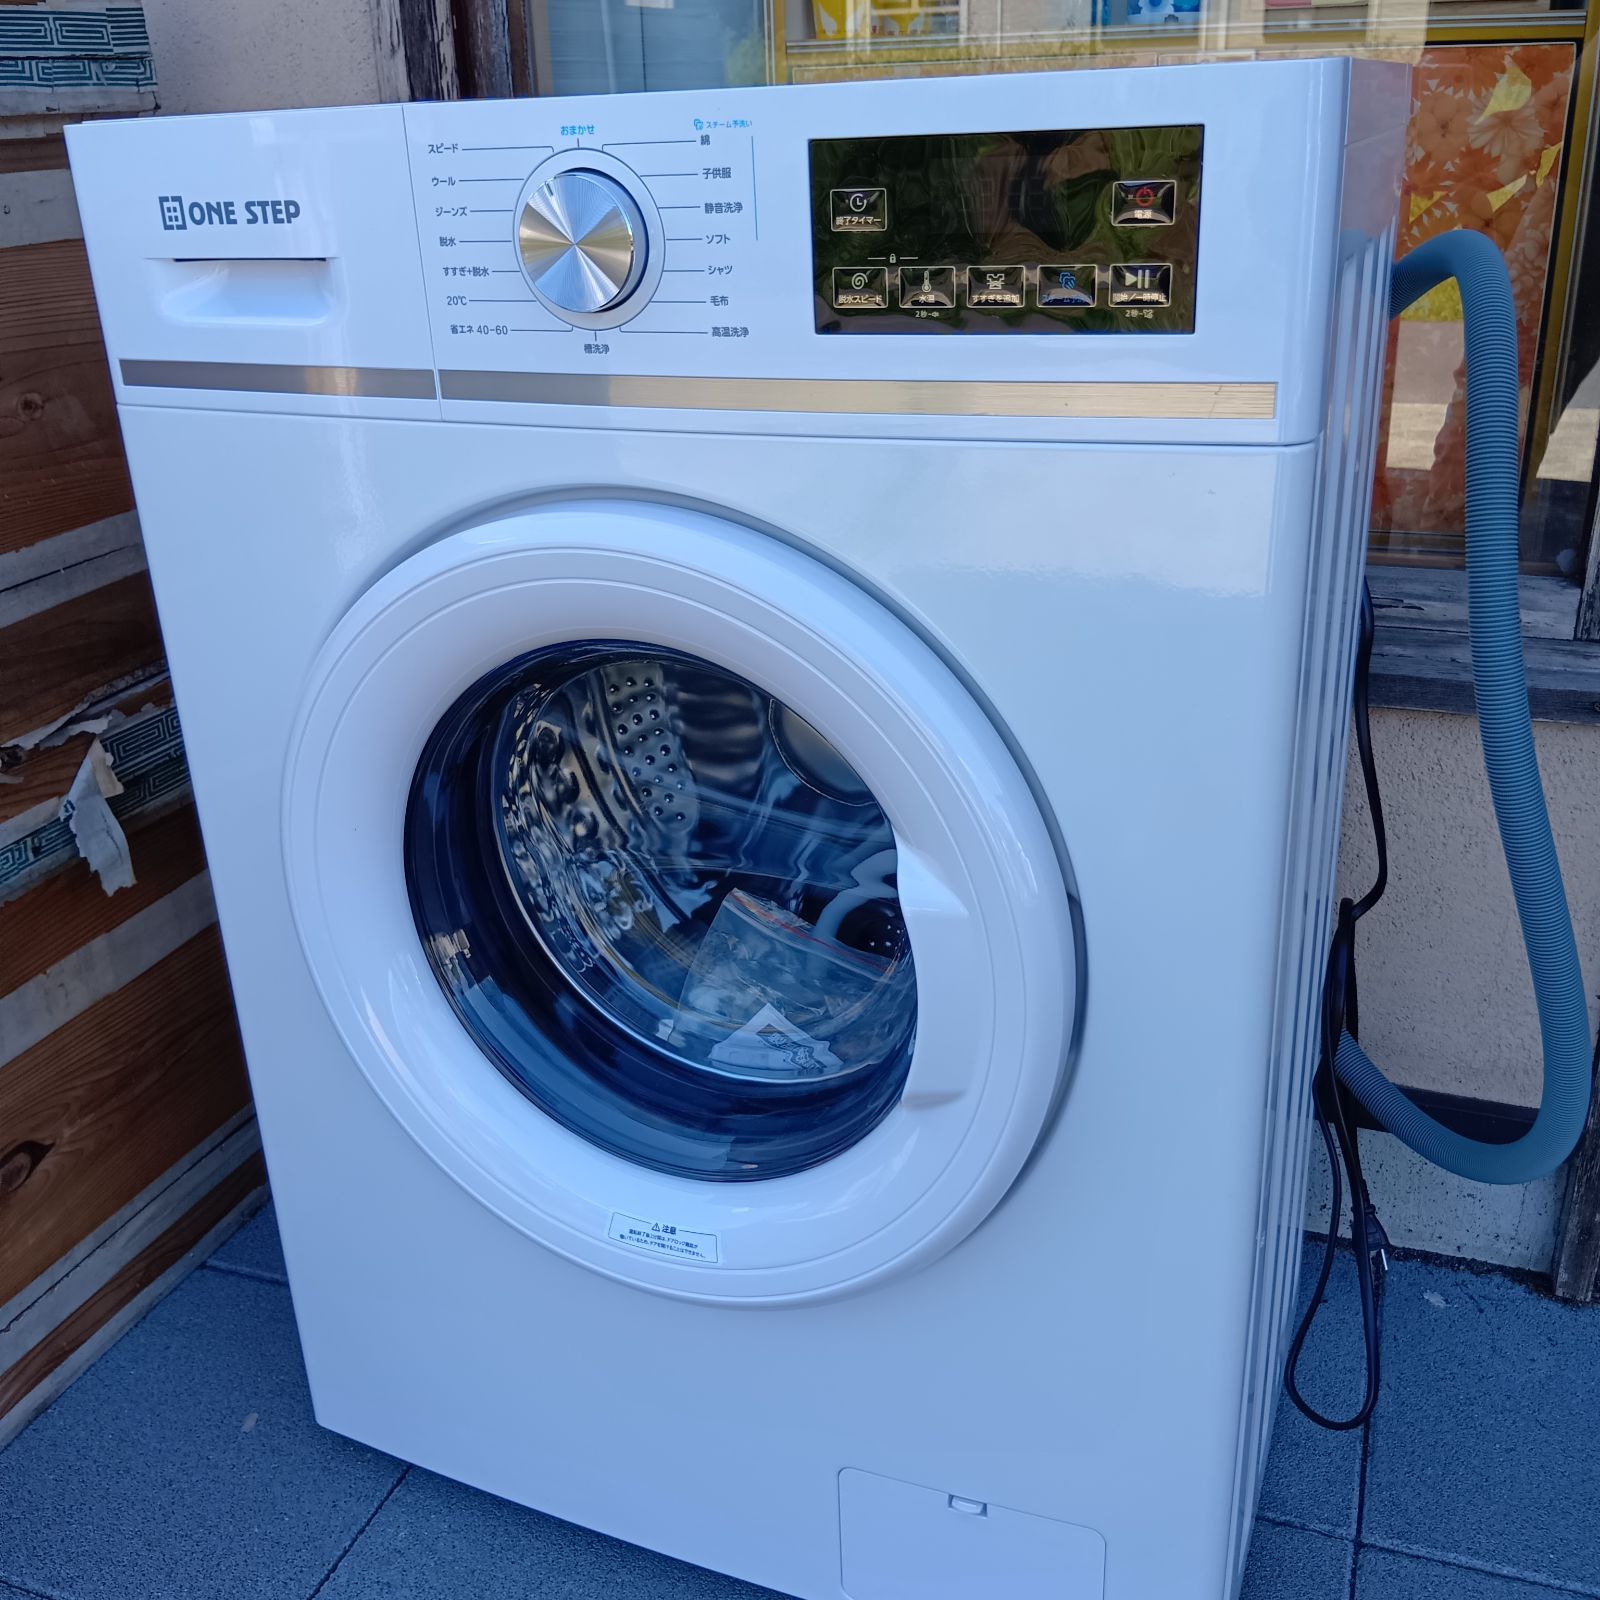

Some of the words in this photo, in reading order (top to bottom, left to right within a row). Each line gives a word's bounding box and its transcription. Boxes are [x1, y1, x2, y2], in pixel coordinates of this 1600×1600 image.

[560, 125, 595, 136] おまかせ
[700, 134, 711, 146] 綿
[427, 143, 459, 154] スピード
[702, 167, 732, 179] 子供服
[431, 176, 456, 187] ウール
[188, 201, 238, 226] ONE
[244, 199, 301, 225] STEP
[435, 206, 468, 217] ジーンズ
[704, 201, 744, 214] 静音洗浄
[835, 216, 882, 226] 終了タイマー
[439, 236, 457, 247] 脱水
[705, 233, 731, 245] ソフト
[442, 266, 490, 278] すすぎ+脱水
[707, 265, 733, 275] シャツ
[710, 295, 729, 306] 毛布
[838, 295, 882, 304] 脱水スピード
[450, 324, 474, 335] 省エネ
[476, 325, 508, 336] 40-60
[711, 326, 750, 338] 高温洗浄
[583, 343, 610, 354] 槽洗浄
[661, 1224, 677, 1235] 注意
